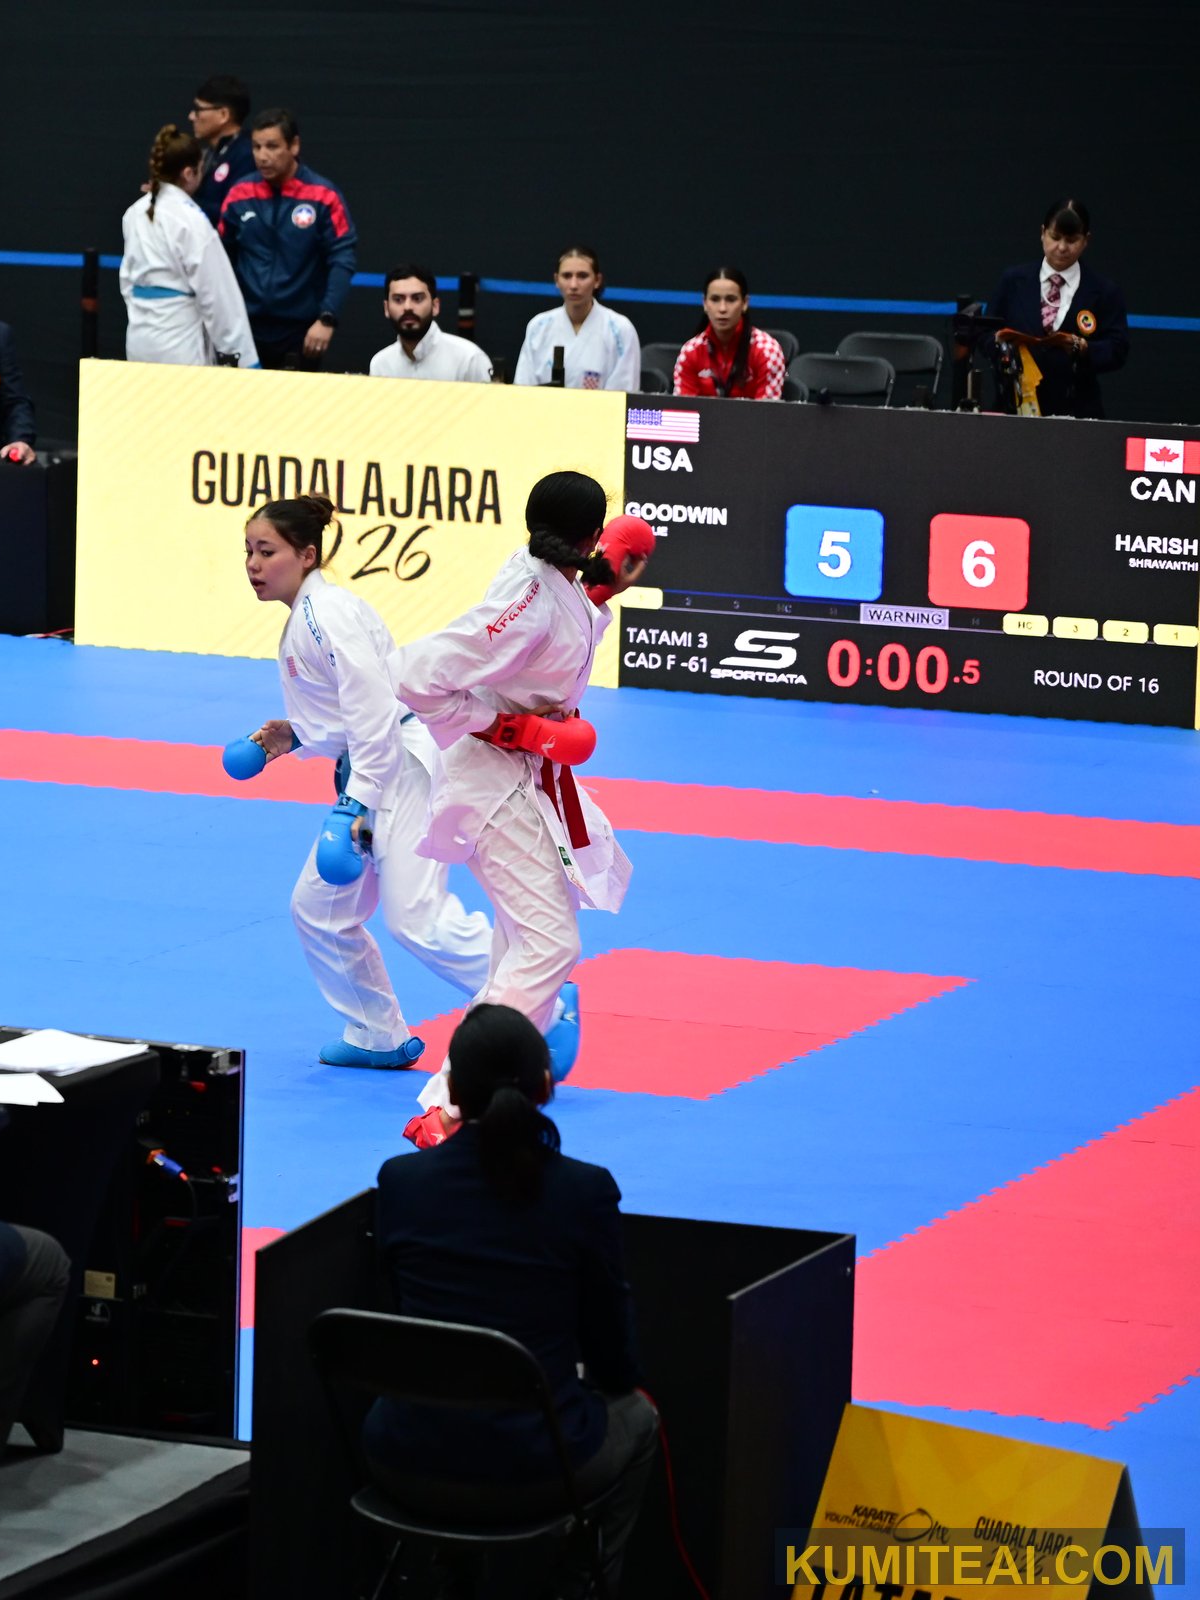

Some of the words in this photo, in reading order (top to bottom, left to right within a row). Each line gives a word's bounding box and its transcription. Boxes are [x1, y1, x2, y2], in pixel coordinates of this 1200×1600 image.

[631, 445, 694, 473] USA
[192, 450, 502, 525] GUADALAJARA
[1130, 476, 1196, 503] CAN
[625, 501, 728, 526] GOODWIN
[324, 520, 433, 581] 26
[817, 530, 852, 578] 5
[1115, 533, 1199, 556] HARISH
[962, 540, 996, 588] 6
[1128, 557, 1199, 572] SHRAVANTHI
[486, 579, 540, 642] Arawaza
[868, 609, 943, 625] WARNING
[1017, 620, 1033, 630] HC
[626, 627, 692, 647] TATAMI
[697, 631, 708, 649] 3
[623, 651, 662, 670] CAD
[666, 654, 676, 671] F
[680, 656, 708, 673] -61
[710, 667, 808, 685] SPORTDATA
[1033, 669, 1102, 689] ROUND
[1107, 674, 1132, 692] OF
[1139, 677, 1160, 694] 16
[851, 1504, 899, 1523] KARATE
